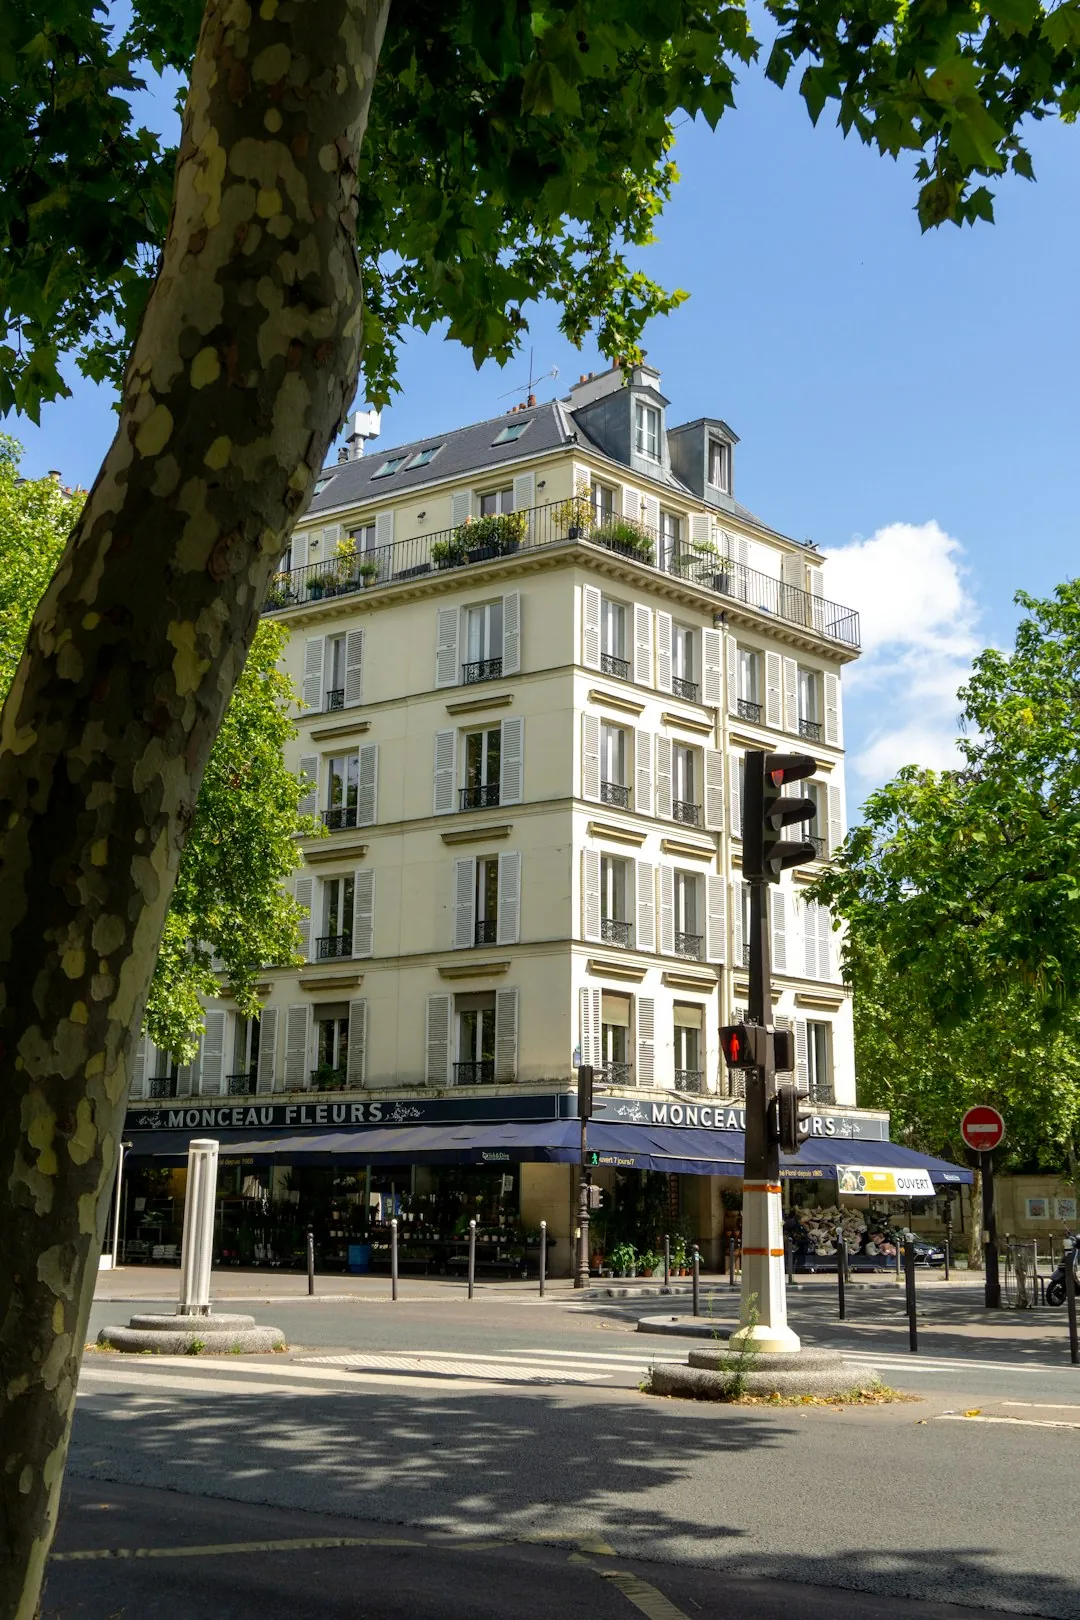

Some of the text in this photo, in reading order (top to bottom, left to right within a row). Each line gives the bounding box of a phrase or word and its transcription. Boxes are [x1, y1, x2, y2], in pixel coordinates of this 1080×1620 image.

[168, 1103, 382, 1127] MONCEAU FLEURS
[897, 1178, 929, 1189] OUVERT
